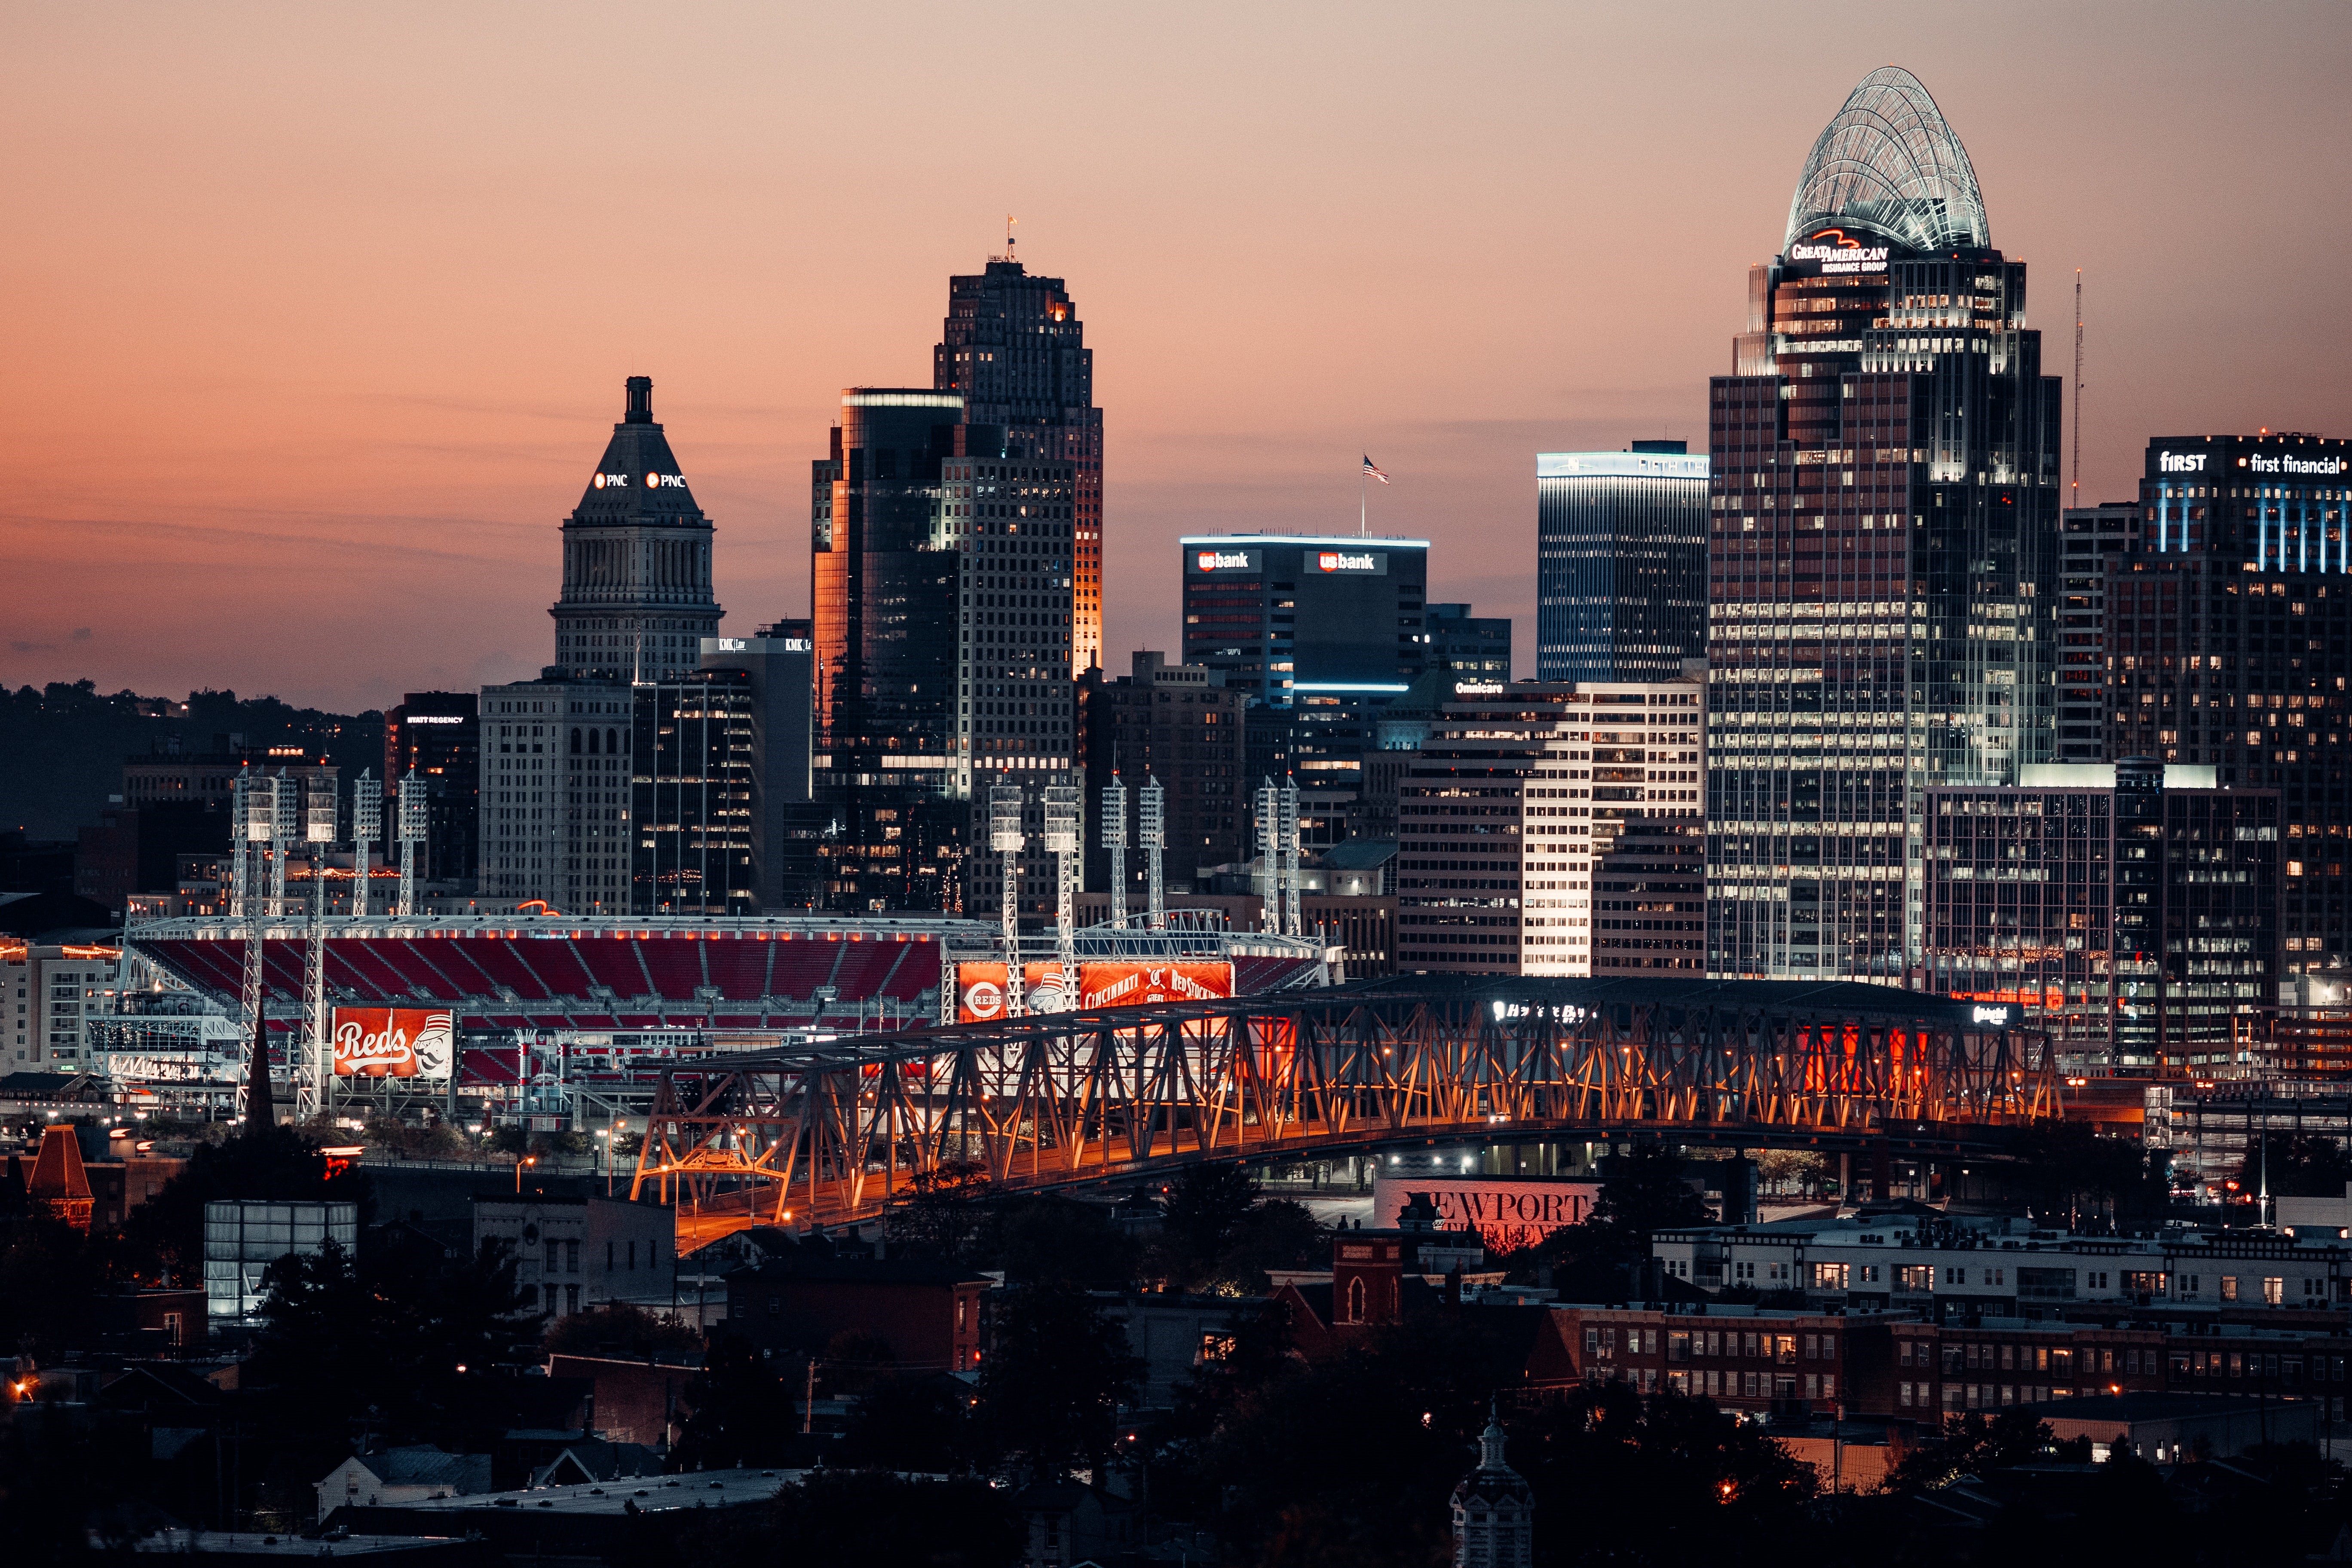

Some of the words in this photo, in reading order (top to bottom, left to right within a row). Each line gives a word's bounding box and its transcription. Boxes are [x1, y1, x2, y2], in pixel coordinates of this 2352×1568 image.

[1792, 244, 1828, 260] GREAT
[1822, 247, 1888, 262] AMERICAN
[1822, 263, 1860, 273] INSURANCE
[1861, 261, 1887, 272] GROUP
[1638, 457, 1678, 472] FIFTH
[1684, 459, 1709, 473] THI
[2250, 453, 2279, 472] first
[2283, 454, 2340, 474] financial
[606, 474, 628, 487] PNC
[661, 475, 686, 487] PNC
[719, 638, 734, 651] KMK
[785, 638, 803, 651] KMK
[1455, 682, 1504, 694] Omnicare
[1085, 973, 1139, 1010] CINCINNATI
[1147, 993, 1164, 1002] GREAT
[974, 995, 1001, 1005] REDS
[334, 1022, 411, 1073] Reds
[1403, 1191, 1588, 1222] EWPORT
